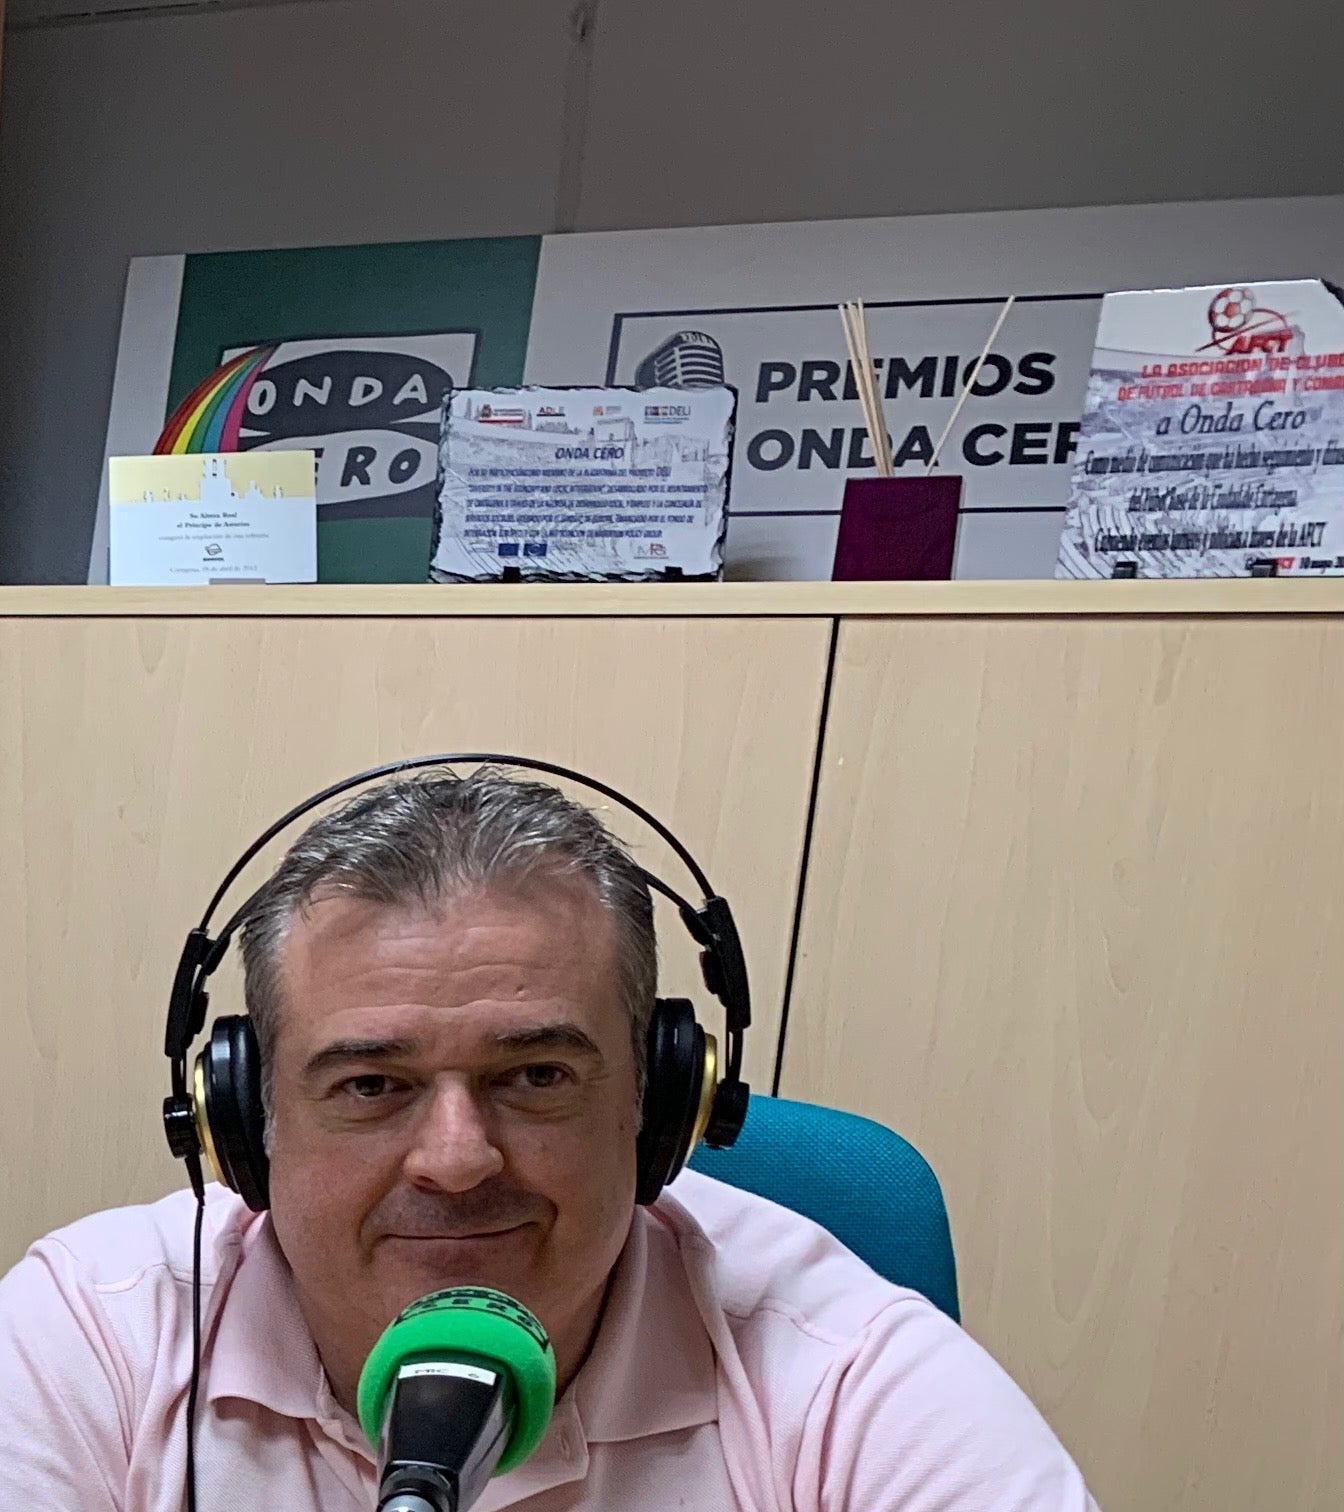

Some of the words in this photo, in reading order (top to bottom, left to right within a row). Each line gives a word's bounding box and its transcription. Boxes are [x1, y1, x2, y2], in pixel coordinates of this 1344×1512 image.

[247, 372, 429, 418] ONDA
[754, 352, 1057, 404] PREMIOS
[1155, 416, 1171, 436] a
[1180, 401, 1244, 435] Onda
[1253, 400, 1307, 431] Cero
[555, 447, 590, 460] ONDA
[593, 447, 625, 460] CERO
[746, 426, 940, 471] ONDA
